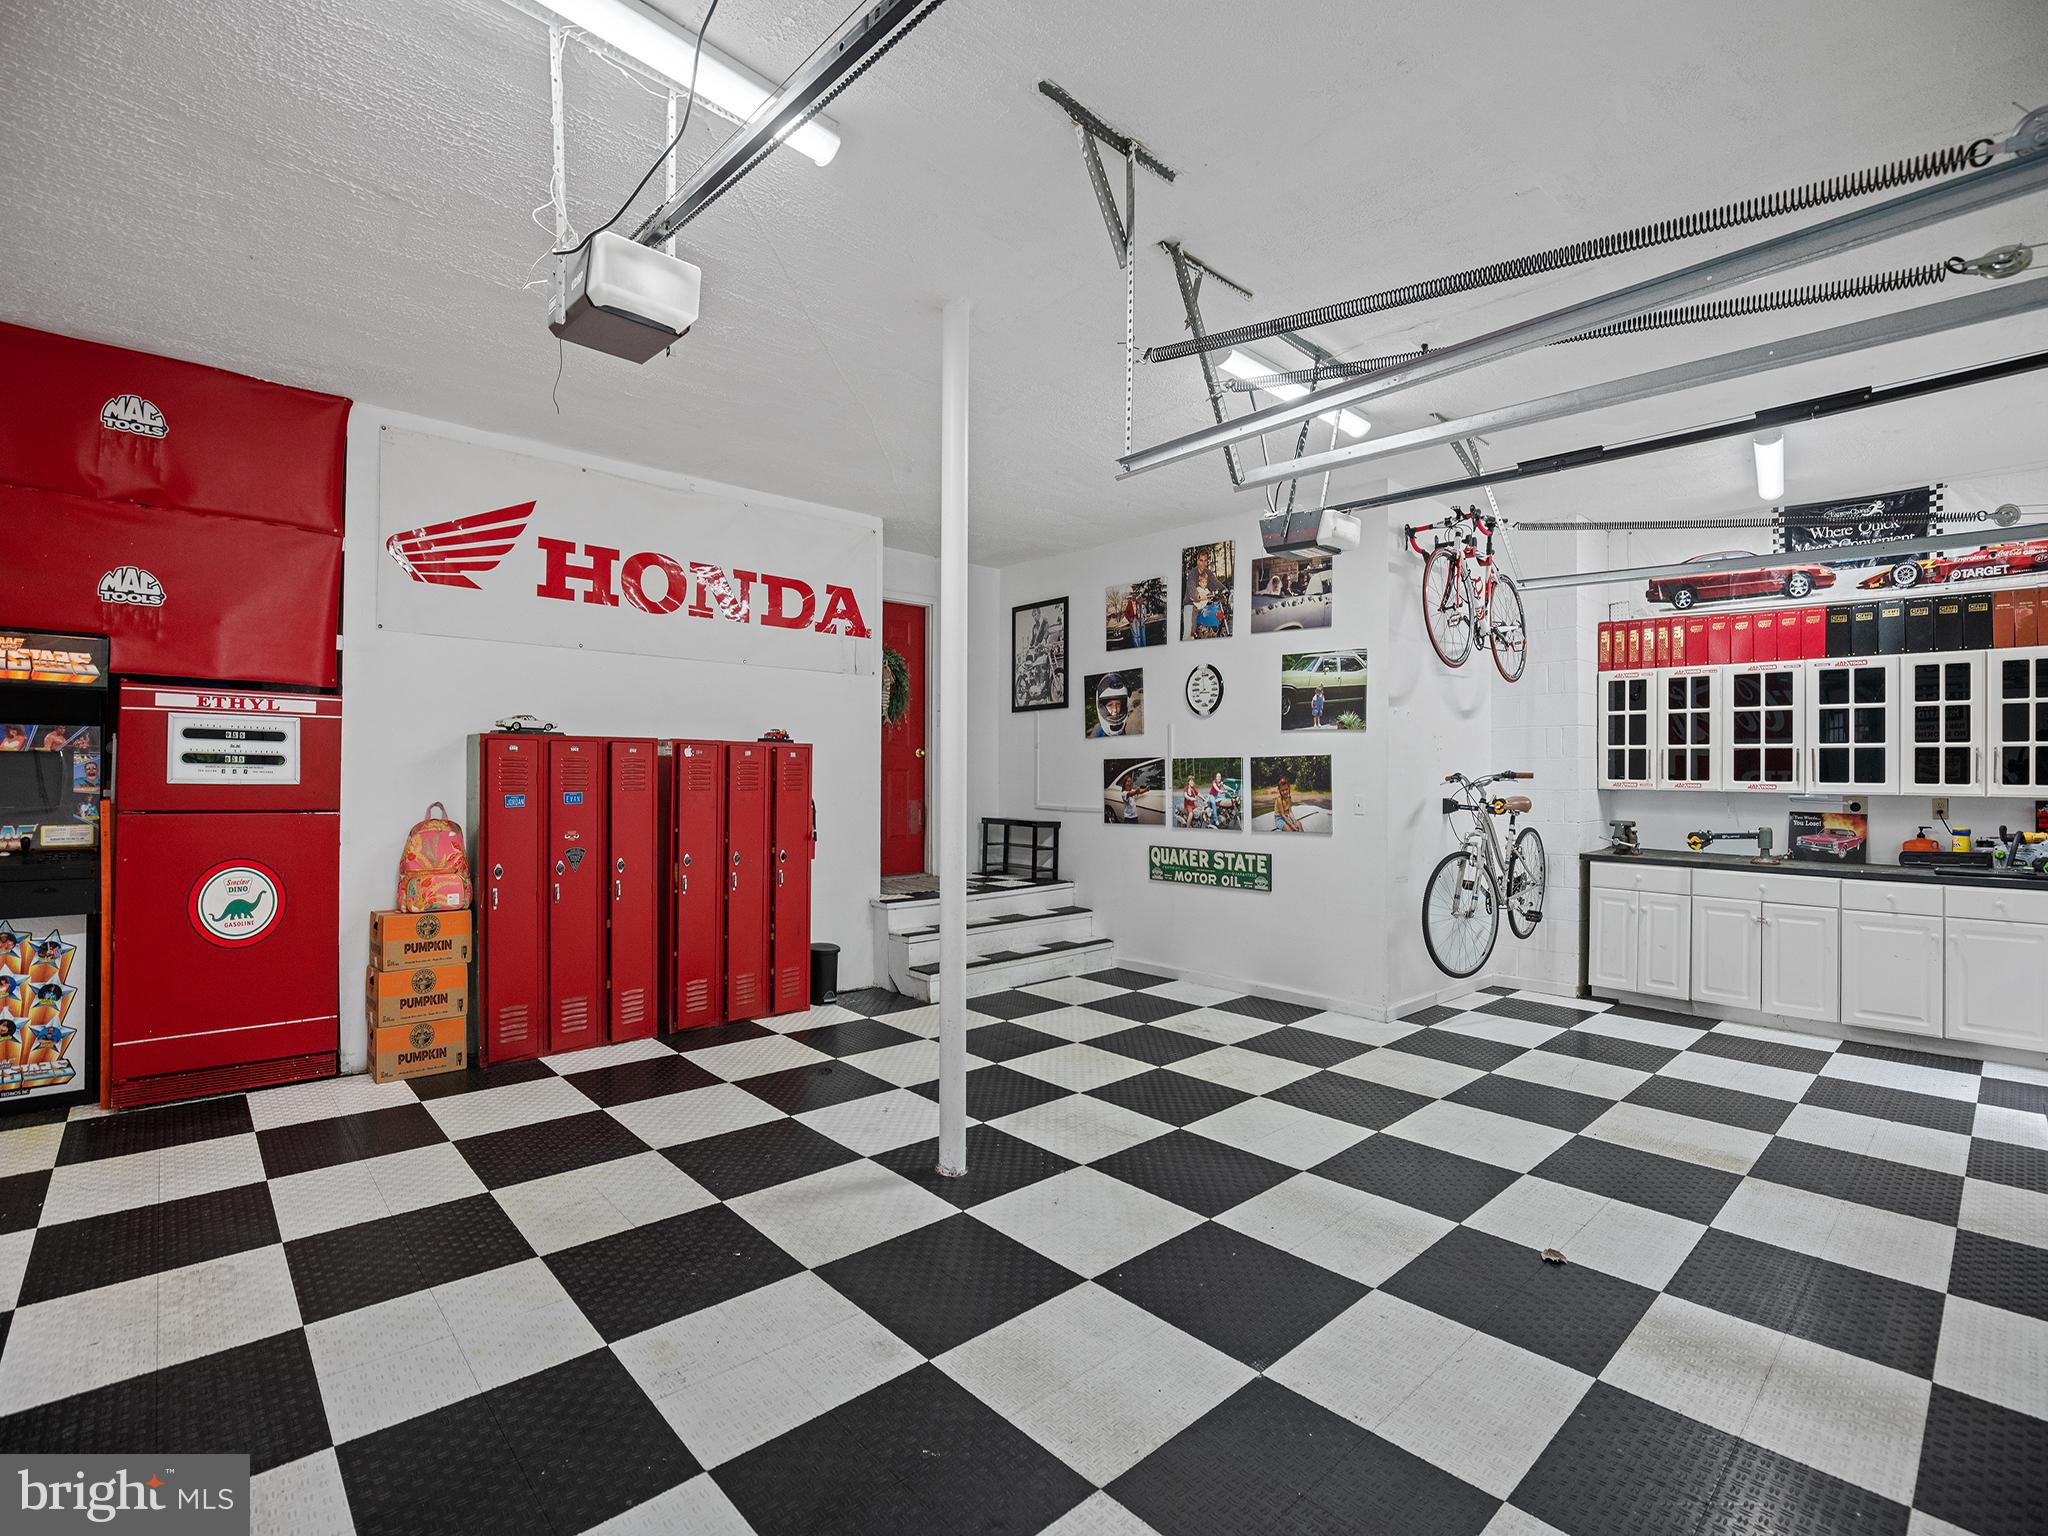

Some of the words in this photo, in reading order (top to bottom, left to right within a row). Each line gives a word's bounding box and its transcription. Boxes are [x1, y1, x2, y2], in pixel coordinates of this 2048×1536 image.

[102, 396, 165, 427] MAC
[103, 417, 167, 437] TOOLS
[1810, 526, 1854, 540] Where
[1858, 519, 1900, 536] Quick
[98, 566, 163, 595] MAC
[1961, 565, 2011, 579] TARGET
[537, 535, 872, 639] HONDA
[100, 592, 163, 606] TOOLS
[195, 695, 281, 711] ETHYL
[506, 798, 525, 806] JORDAN
[1150, 846, 1210, 868] QUAKER
[1213, 851, 1268, 874] STATE
[226, 878, 251, 887] Sinclair
[1174, 870, 1217, 885] MOTOR
[1221, 875, 1241, 887] OIL
[223, 920, 255, 928] GASOLINE
[403, 939, 453, 955] PUMPKIN
[399, 992, 448, 1010] PUMPKIN
[397, 1047, 447, 1065] PUMPKIN
